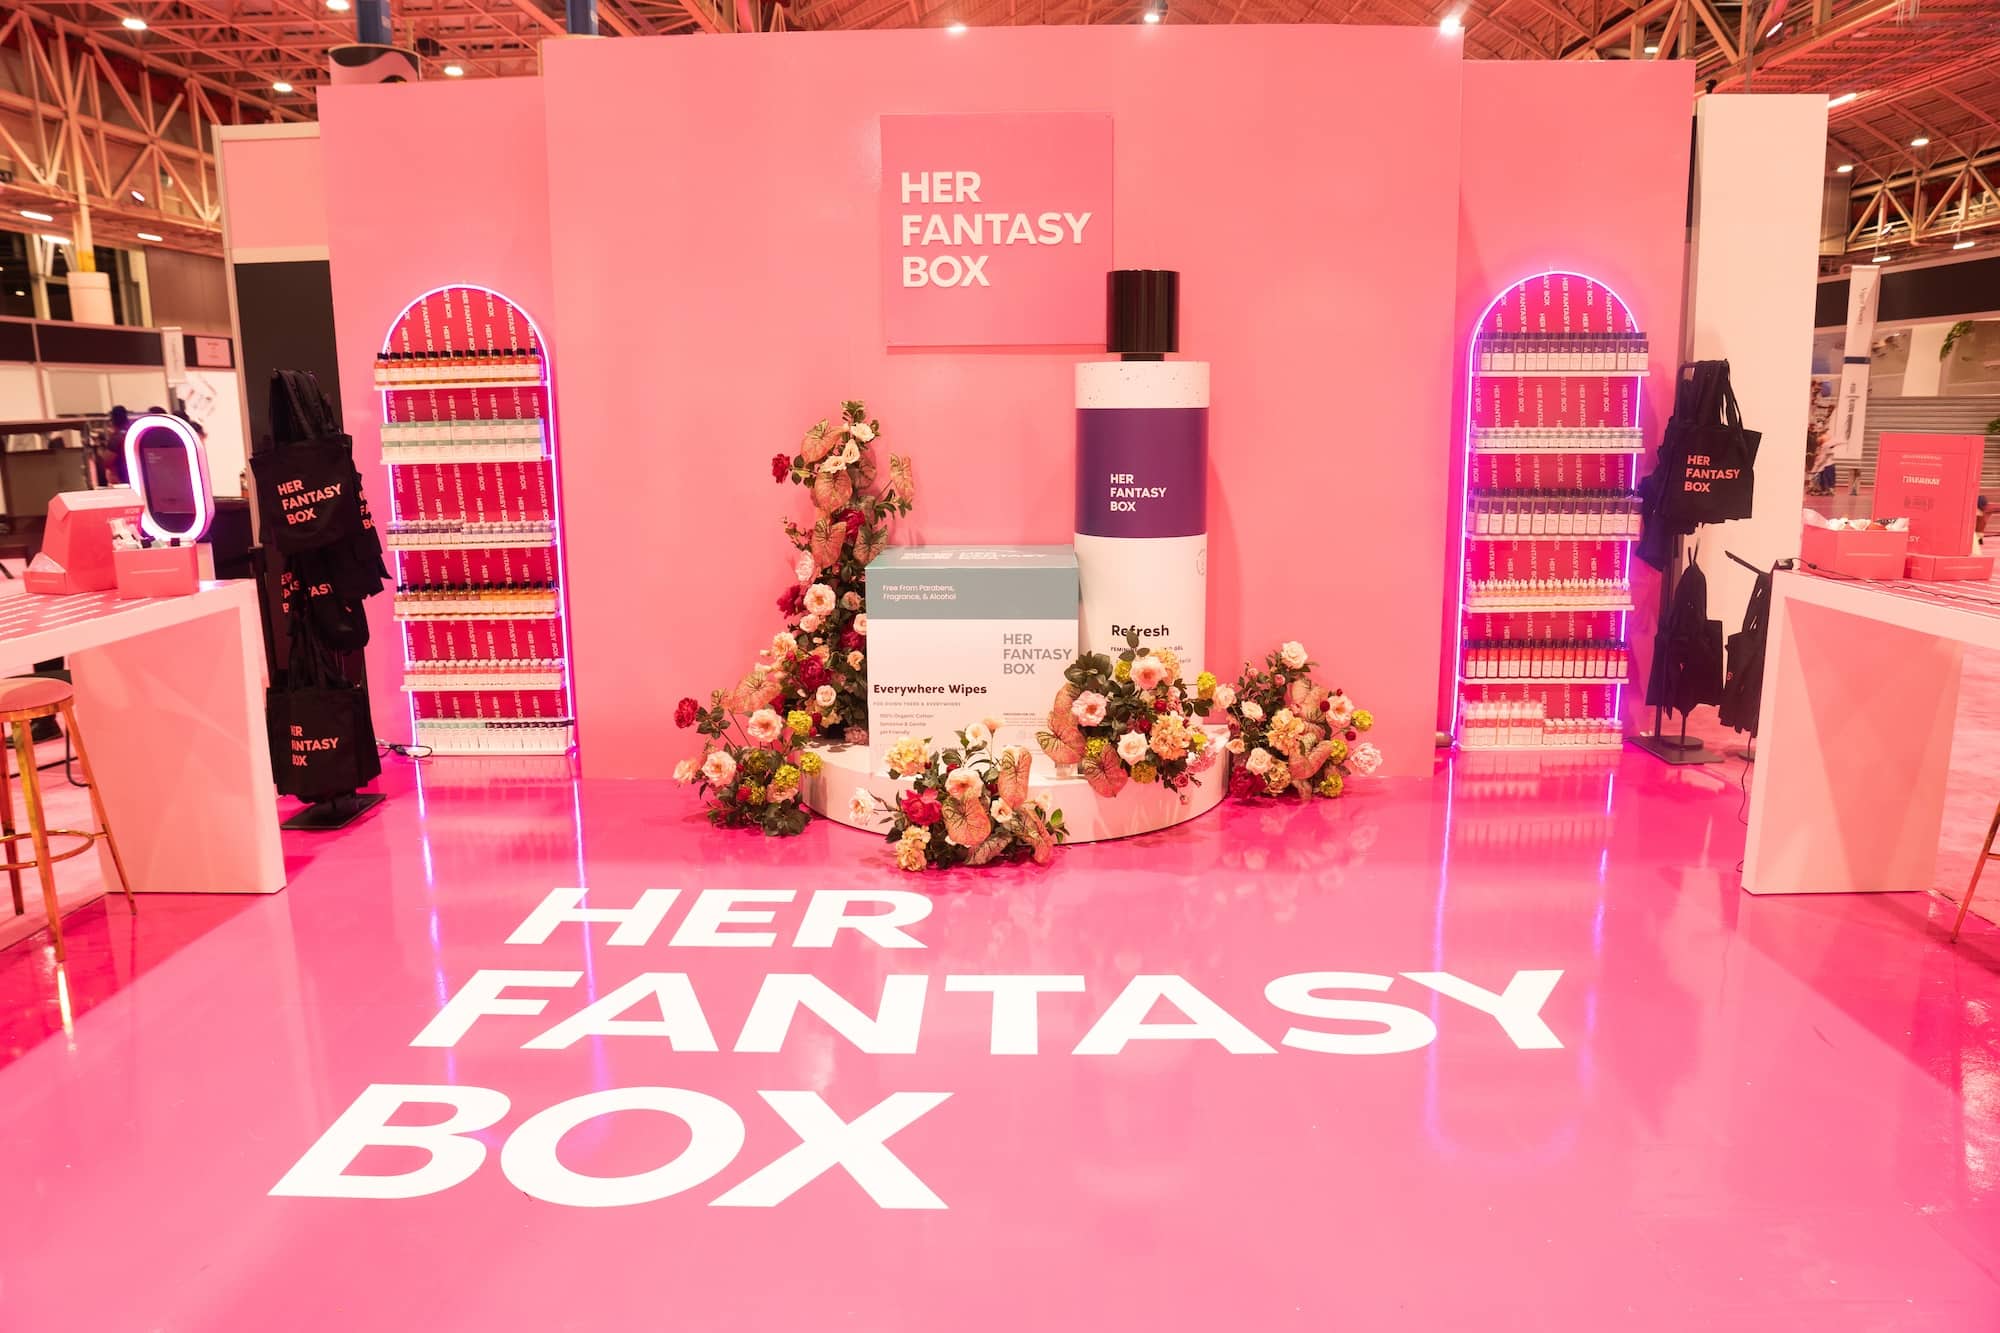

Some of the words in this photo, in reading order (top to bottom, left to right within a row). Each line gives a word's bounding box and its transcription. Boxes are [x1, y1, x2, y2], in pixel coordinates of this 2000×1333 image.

[901, 171, 982, 204] HER
[902, 212, 1092, 246] FANTASY
[903, 255, 991, 288] BOX
[1687, 455, 1711, 466] HER
[1110, 473, 1134, 484] HER
[1685, 468, 1740, 480] FANTASY
[277, 480, 304, 496] HER
[1110, 487, 1167, 498] FANTASY
[1684, 481, 1711, 493] BOX
[282, 483, 341, 510] FANTASY
[1110, 501, 1136, 512] BOX
[286, 508, 317, 525] BOX
[1003, 633, 1033, 645] HER
[1003, 648, 1072, 660] FANTASY
[1003, 663, 1036, 675] BOX
[873, 684, 945, 697] Everywhere
[948, 684, 987, 697] Wipes
[503, 887, 934, 950] HER
[408, 969, 1565, 1056] FANTASY
[267, 1083, 953, 1211] BOX
